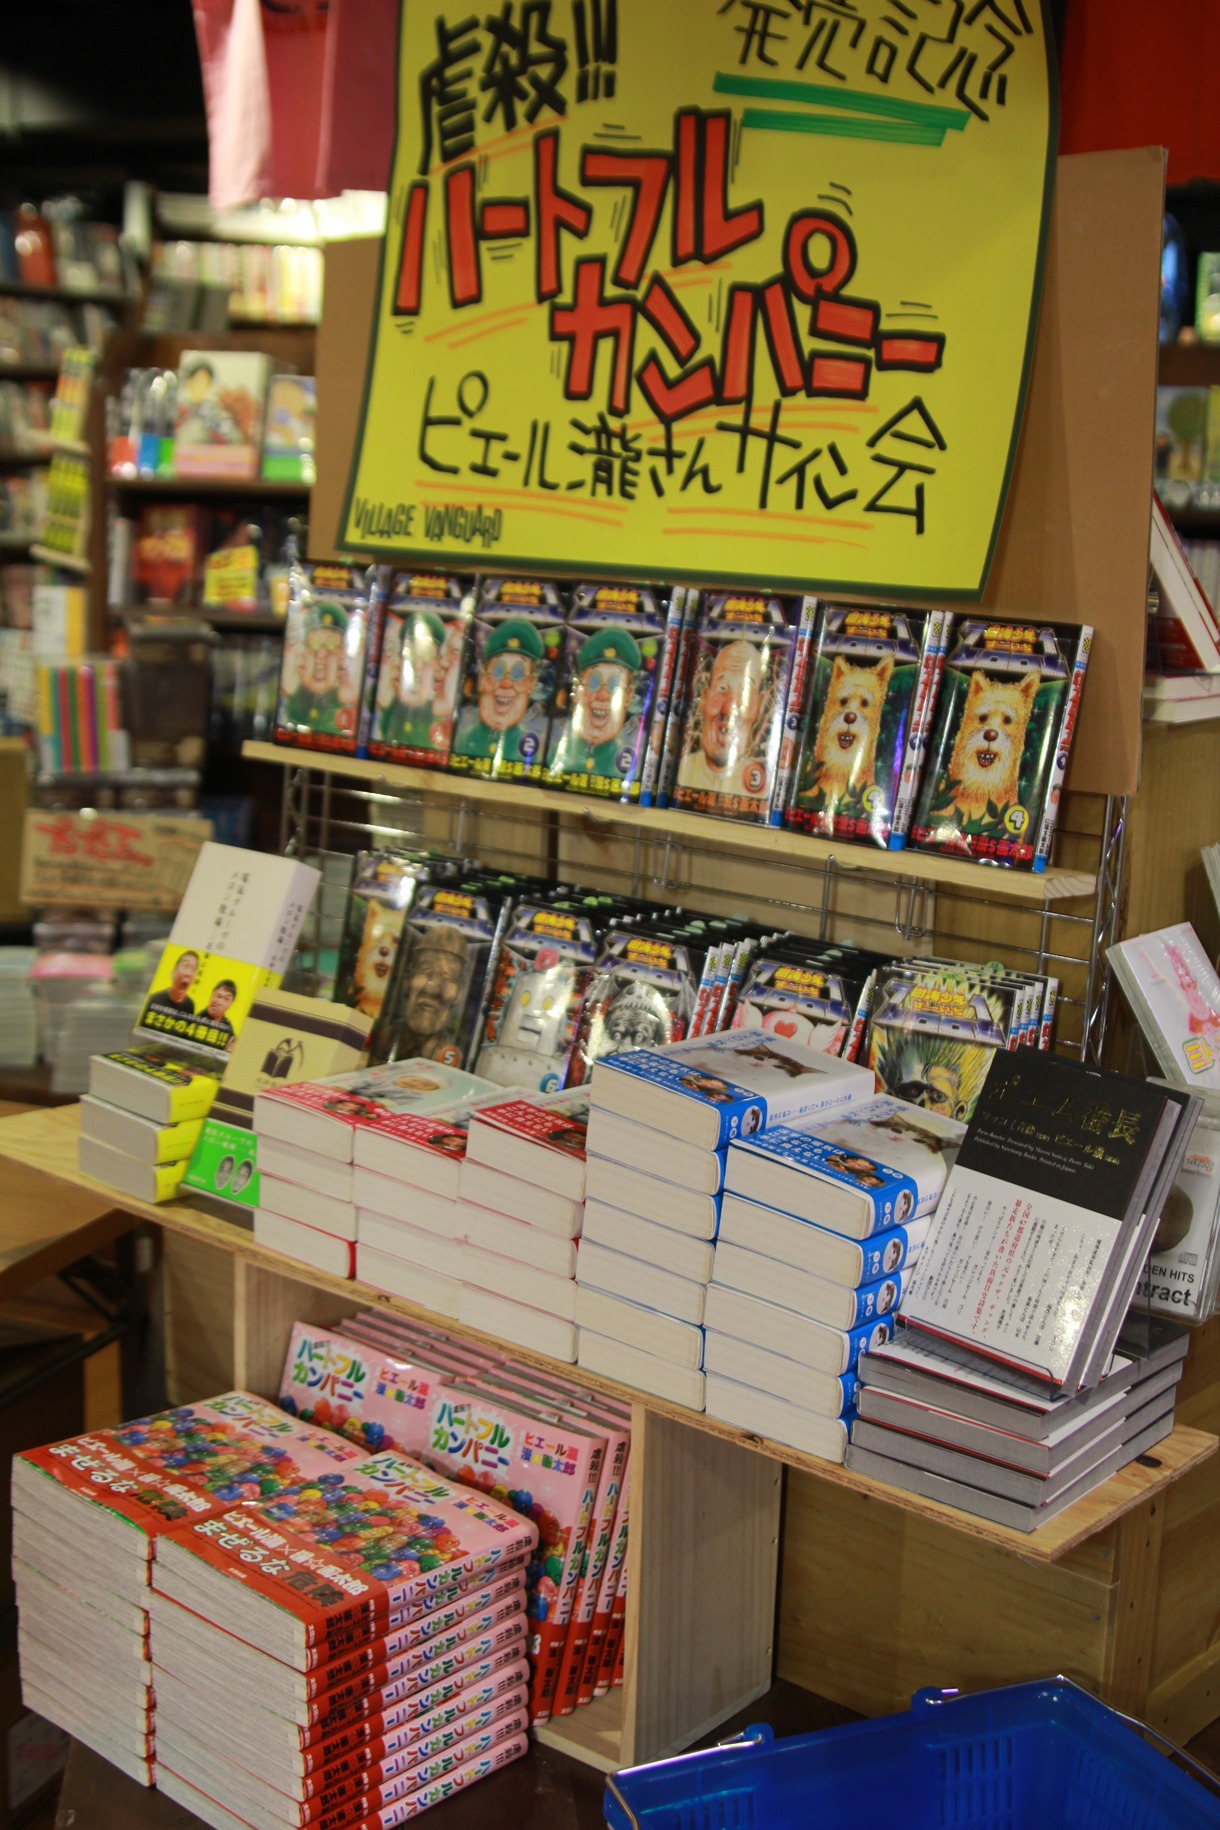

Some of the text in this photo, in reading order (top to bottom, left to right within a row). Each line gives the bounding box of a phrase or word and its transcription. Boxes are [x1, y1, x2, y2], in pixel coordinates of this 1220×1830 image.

[716, 0, 1032, 120] 発売記念
[392, 105, 764, 316] ハートフル
[551, 208, 945, 422] カンパニー
[419, 370, 946, 535] ピエール瀧さんサイン会
[353, 498, 501, 548] VILLAGE VANGUARD
[750, 770, 761, 786] 3
[1009, 809, 1025, 830] 4
[444, 1050, 455, 1064] 5
[1169, 1268, 1195, 1284] HITS
[292, 1361, 364, 1402] カンパニー
[297, 1339, 366, 1382] ハートフル
[432, 1426, 510, 1469] カンパニー
[437, 1402, 510, 1448] ハートフル
[392, 1549, 502, 1602] ハートフルカンパニー
[561, 1488, 594, 1624] ハートフルカンパニー
[585, 1481, 618, 1620] ハートフルカンパニー
[389, 1592, 491, 1652] ハートフルカンパニー
[391, 1615, 493, 1675] ハートフルカンパニー
[385, 1638, 492, 1699] ハートフルカンパニー
[387, 1663, 491, 1725] ハートフルカンパニー
[385, 1711, 491, 1773] ハートフルカンパニー
[388, 1687, 493, 1749] ハートフルカンパニー
[384, 1759, 491, 1824] ハートフルカンパニー
[385, 1735, 491, 1798] ハートフルカンパニー
